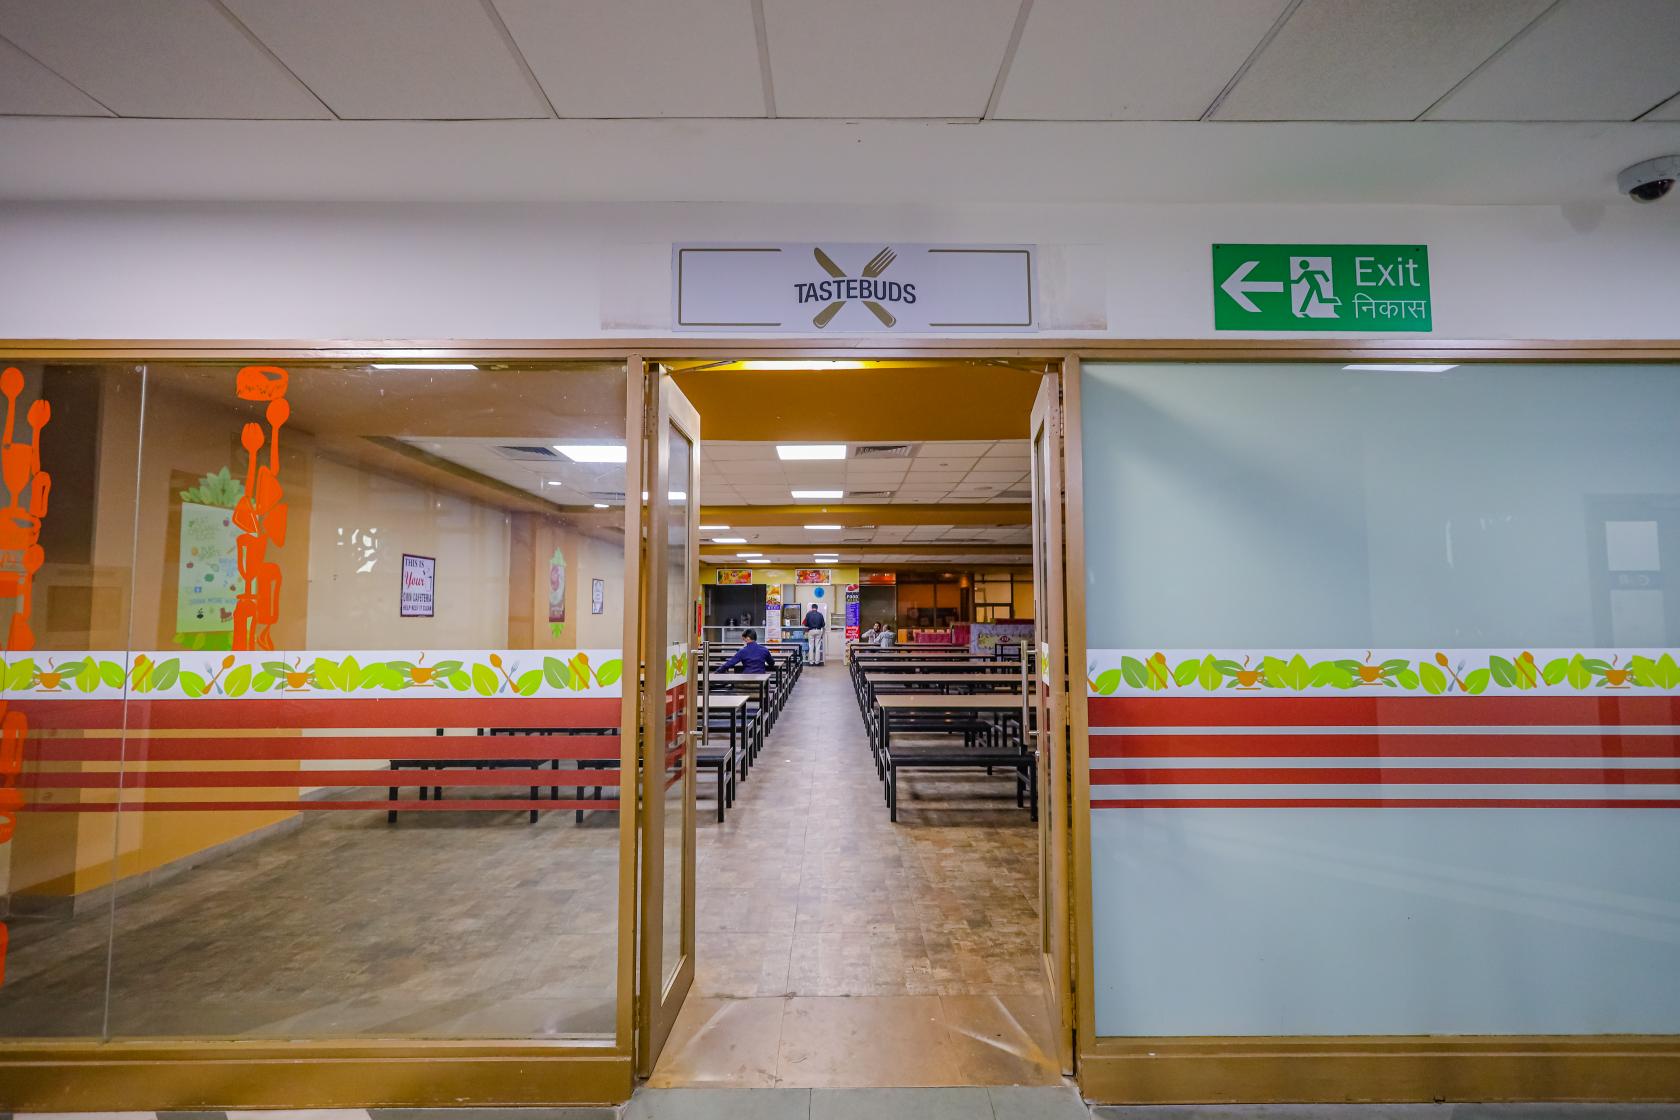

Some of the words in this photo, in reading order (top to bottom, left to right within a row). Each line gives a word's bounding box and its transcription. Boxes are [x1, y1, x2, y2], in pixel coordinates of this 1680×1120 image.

[1355, 257, 1421, 287] Exit
[794, 279, 916, 304] TASTEBUDS
[1352, 293, 1426, 319] निकास
[405, 559, 418, 567] THIS
[405, 570, 424, 588] Your
